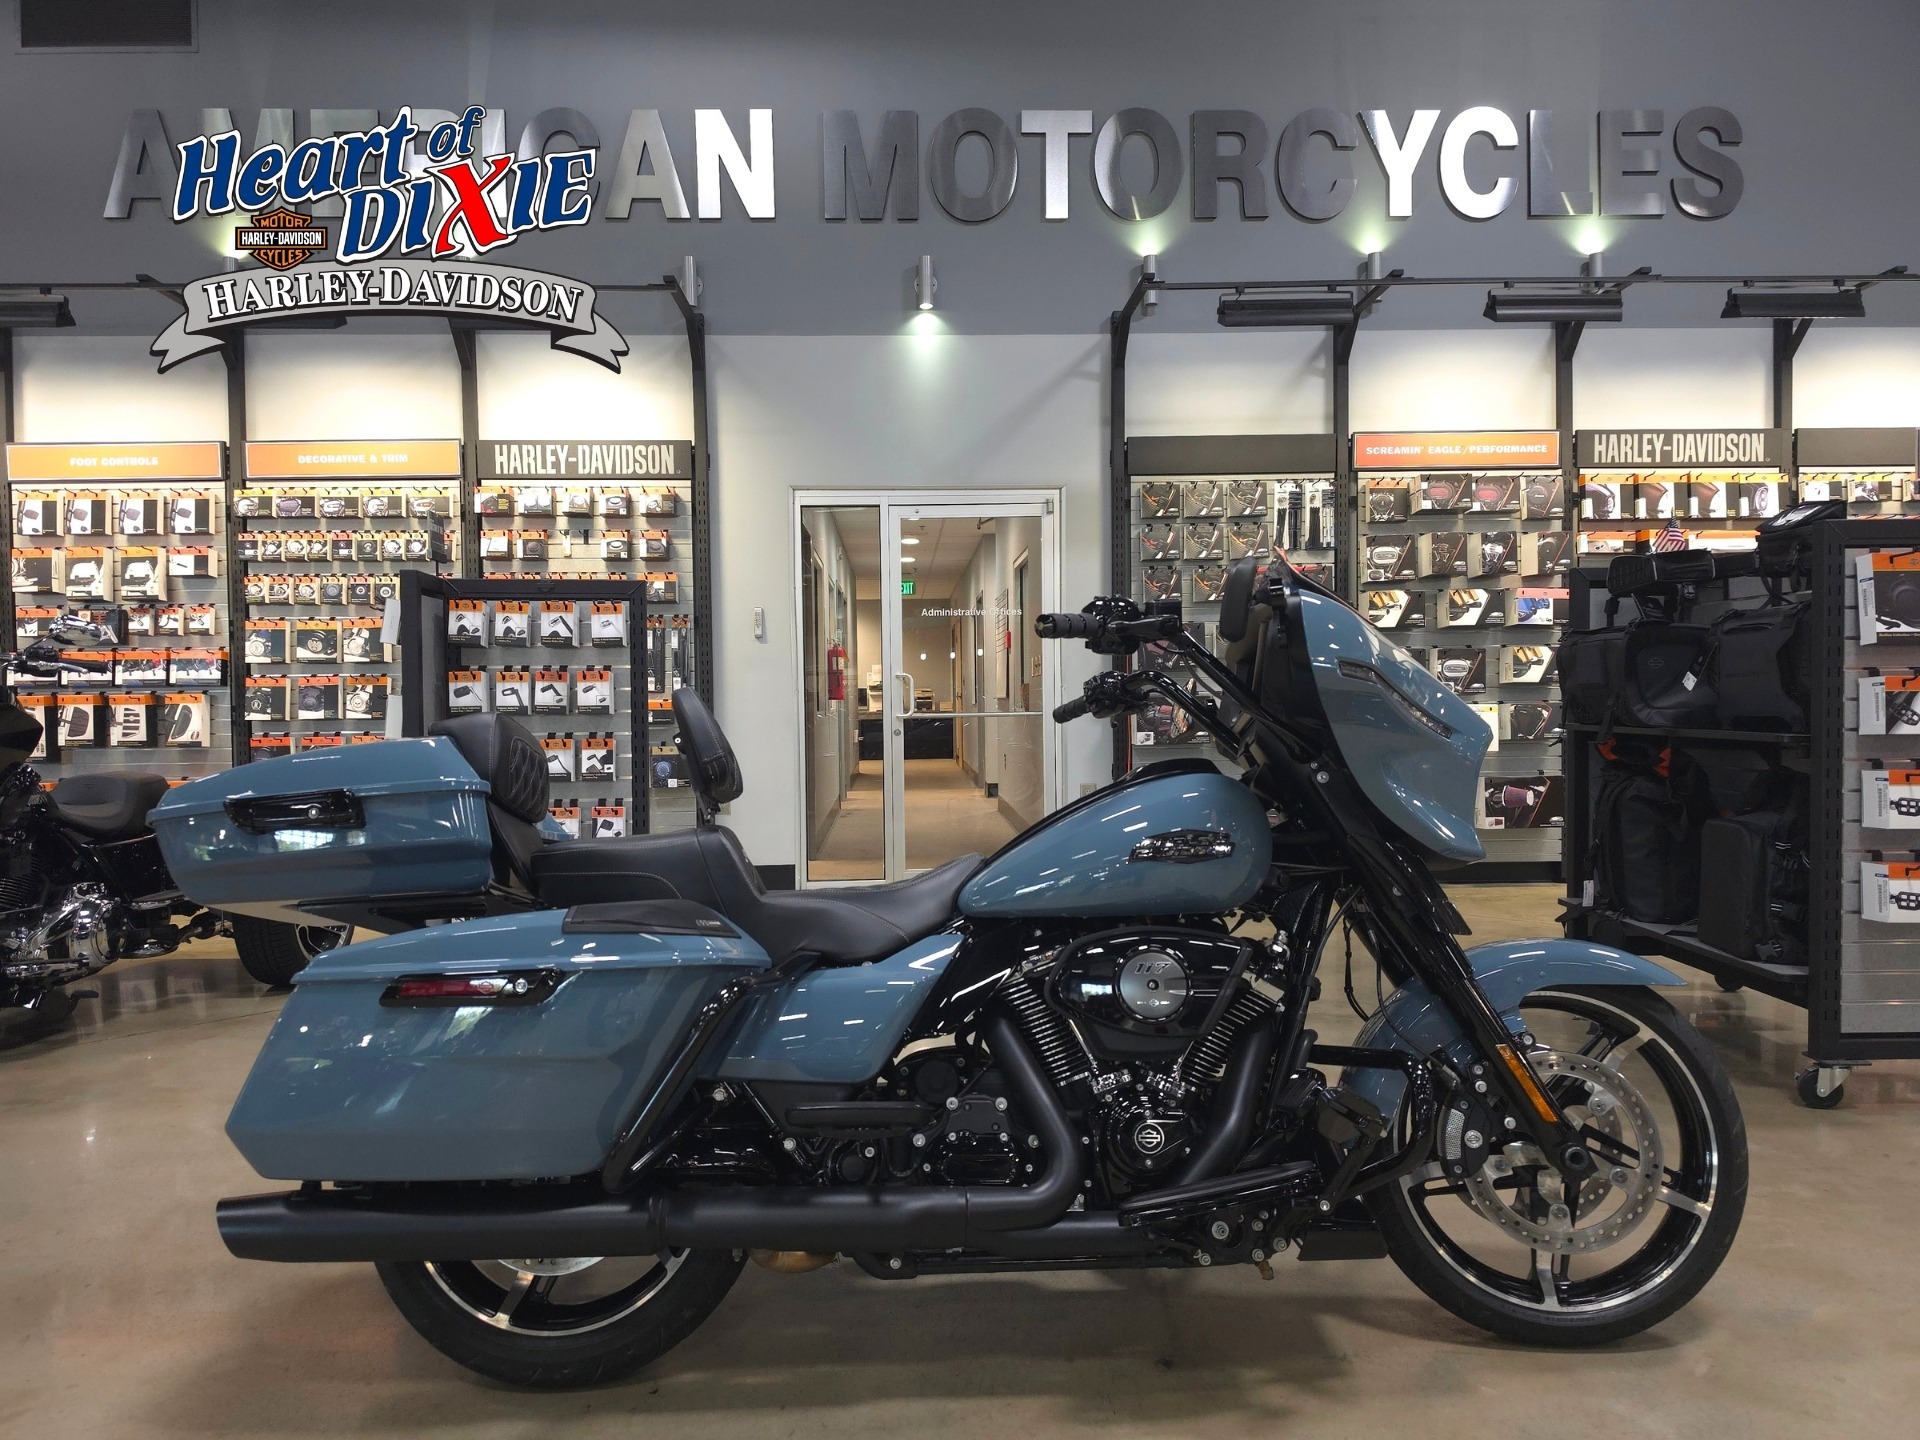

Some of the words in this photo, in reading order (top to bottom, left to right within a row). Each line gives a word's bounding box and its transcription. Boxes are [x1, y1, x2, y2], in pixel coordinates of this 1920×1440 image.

[821, 105, 1745, 223] MOTORCYCLES
[1365, 445, 1424, 455] SCREAMIN'
[1593, 433, 1765, 463] HARLEY-DAVIDSON
[69, 457, 97, 467] FOOT
[101, 456, 159, 466] CONTROLS
[297, 454, 364, 464] DECORATIVE
[369, 454, 379, 464] &
[381, 453, 408, 463] TRIM
[494, 444, 674, 475] HARLEY-DAVIDSON
[921, 608, 985, 617] Administrative
[1134, 961, 1172, 975] 117
